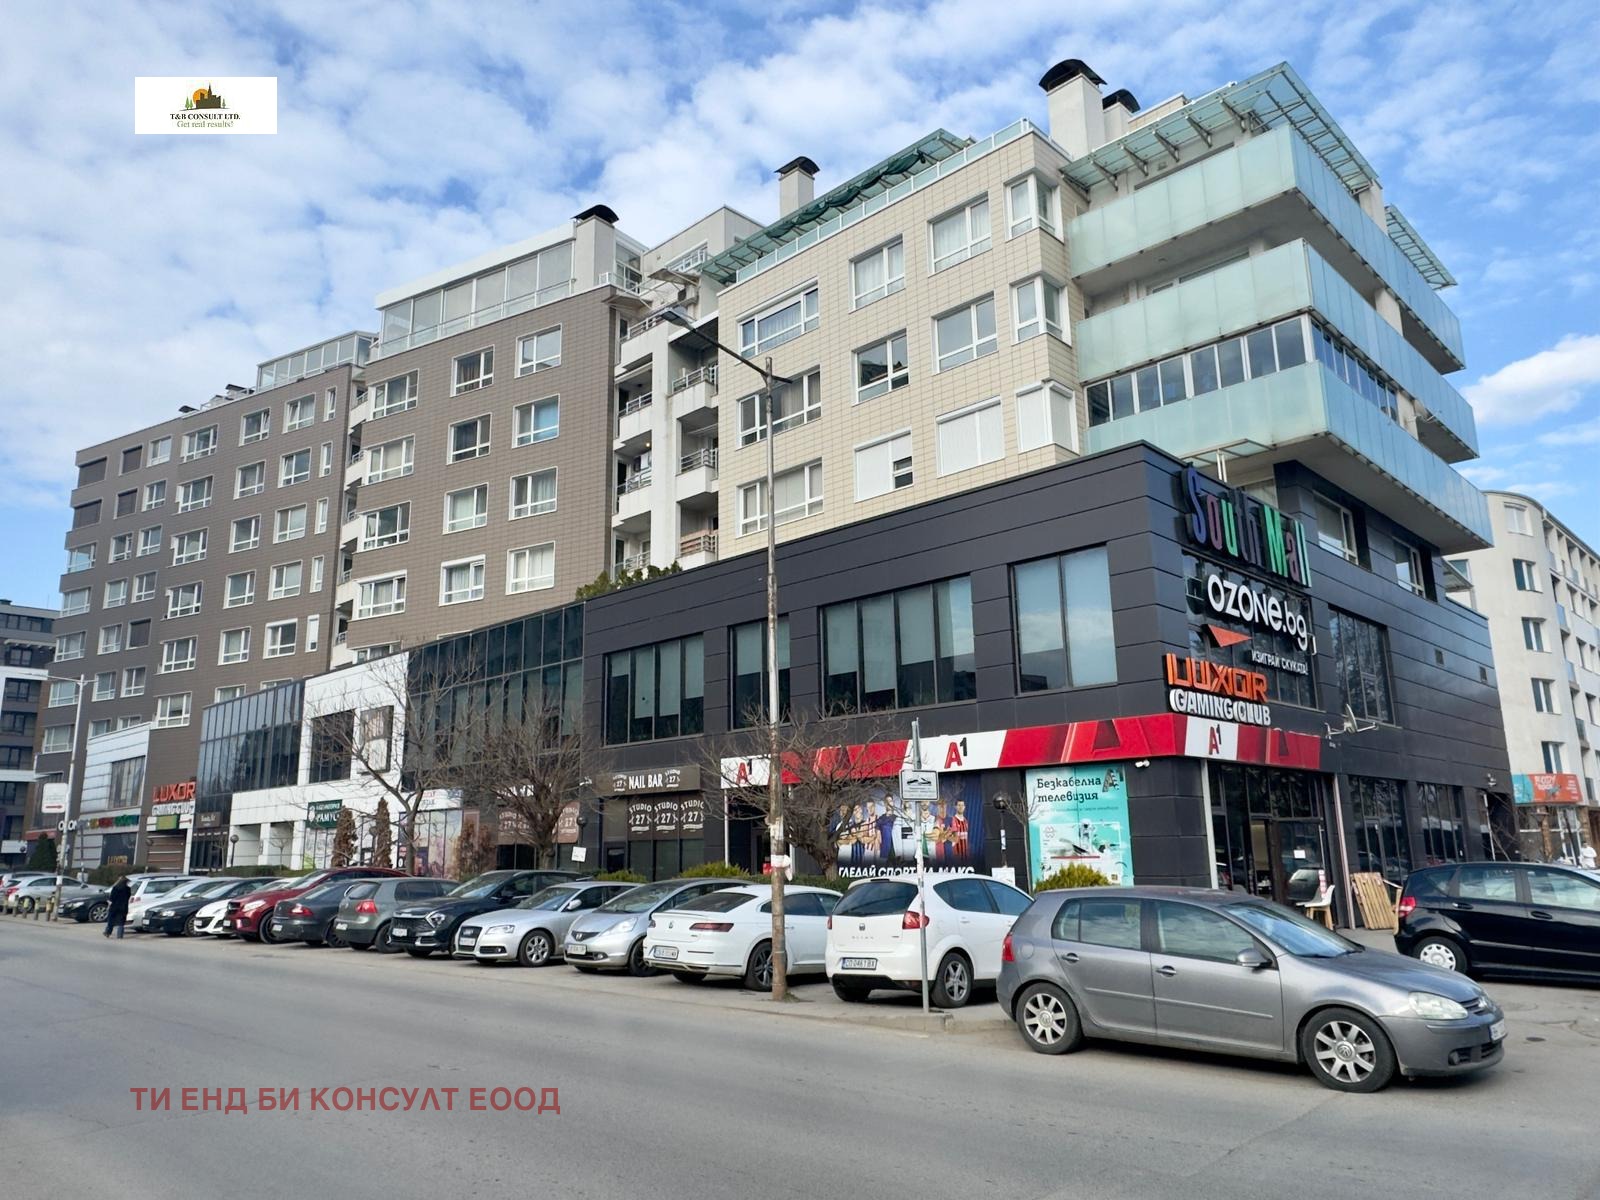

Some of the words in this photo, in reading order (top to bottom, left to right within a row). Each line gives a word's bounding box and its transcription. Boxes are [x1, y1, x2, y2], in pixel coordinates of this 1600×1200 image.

[1166, 652, 1269, 703] LUXOR
[1169, 688, 1234, 720] GAMING
[945, 737, 969, 769] A1
[628, 775, 646, 790] NAIL
[647, 773, 663, 788] BAR
[1036, 777, 1102, 790] Безкабелна
[152, 781, 196, 802] LUXOR
[1037, 791, 1099, 803] телевизия
[628, 803, 652, 814] STUDIO
[654, 801, 679, 813] STUDIO
[635, 814, 646, 825] 27
[660, 812, 671, 824] 27
[687, 811, 699, 822] 27
[838, 865, 876, 878] ГЛЕДАЙ
